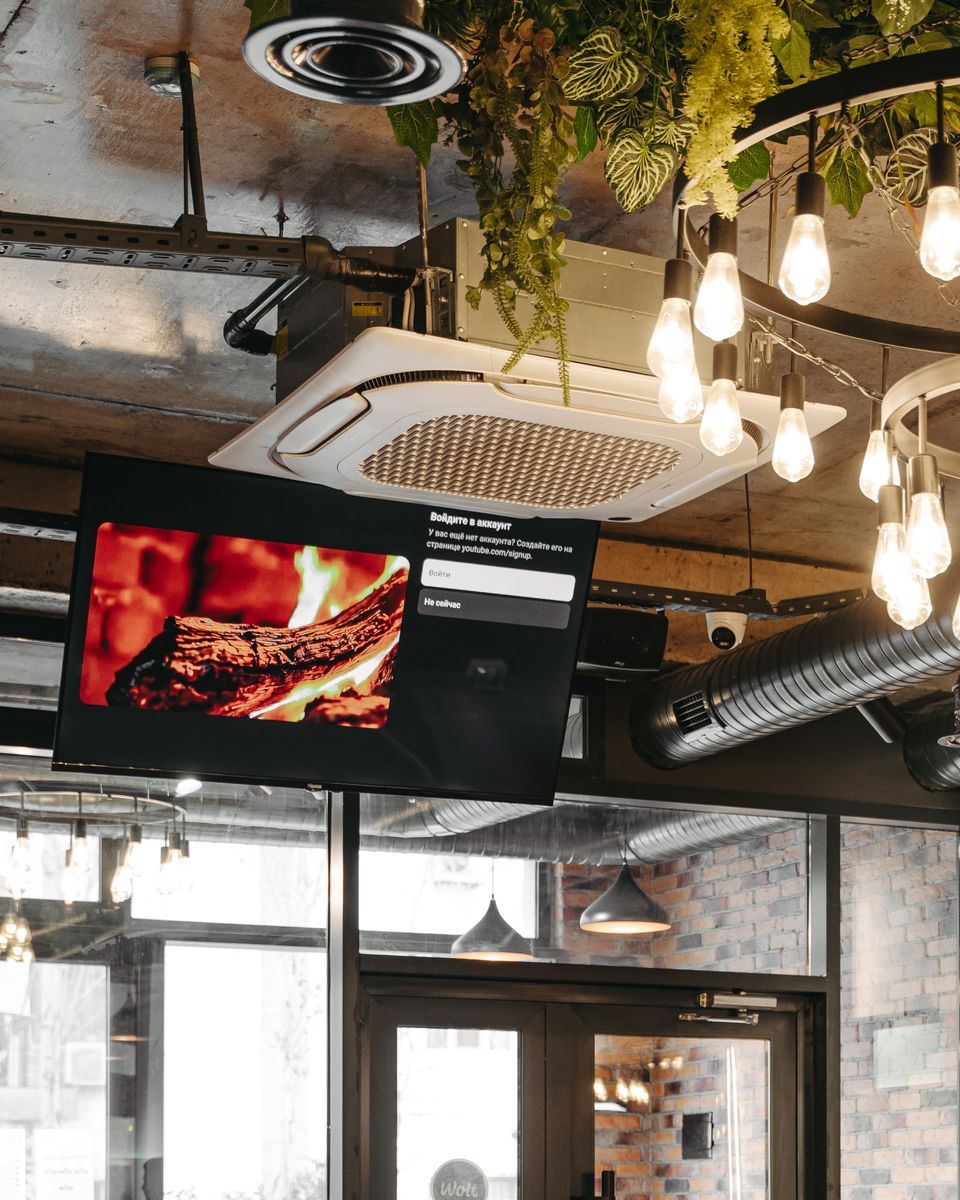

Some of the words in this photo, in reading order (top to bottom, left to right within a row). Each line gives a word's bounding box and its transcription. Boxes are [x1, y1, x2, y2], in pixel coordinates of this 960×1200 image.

[430, 511, 468, 525] Войдите
[469, 518, 476, 526] в
[476, 519, 512, 531] аккаунт
[428, 528, 434, 536] У
[435, 530, 448, 538] вас
[449, 532, 464, 540] ещё
[479, 536, 515, 546] аккаунта?
[516, 540, 550, 550] Создайте
[426, 541, 461, 552] странице
[461, 546, 533, 560] youtube.com/signup.
[428, 569, 451, 578] Войти
[424, 597, 434, 606] Не
[435, 599, 461, 609] сейчас
[440, 1181, 479, 1197] Wolt
